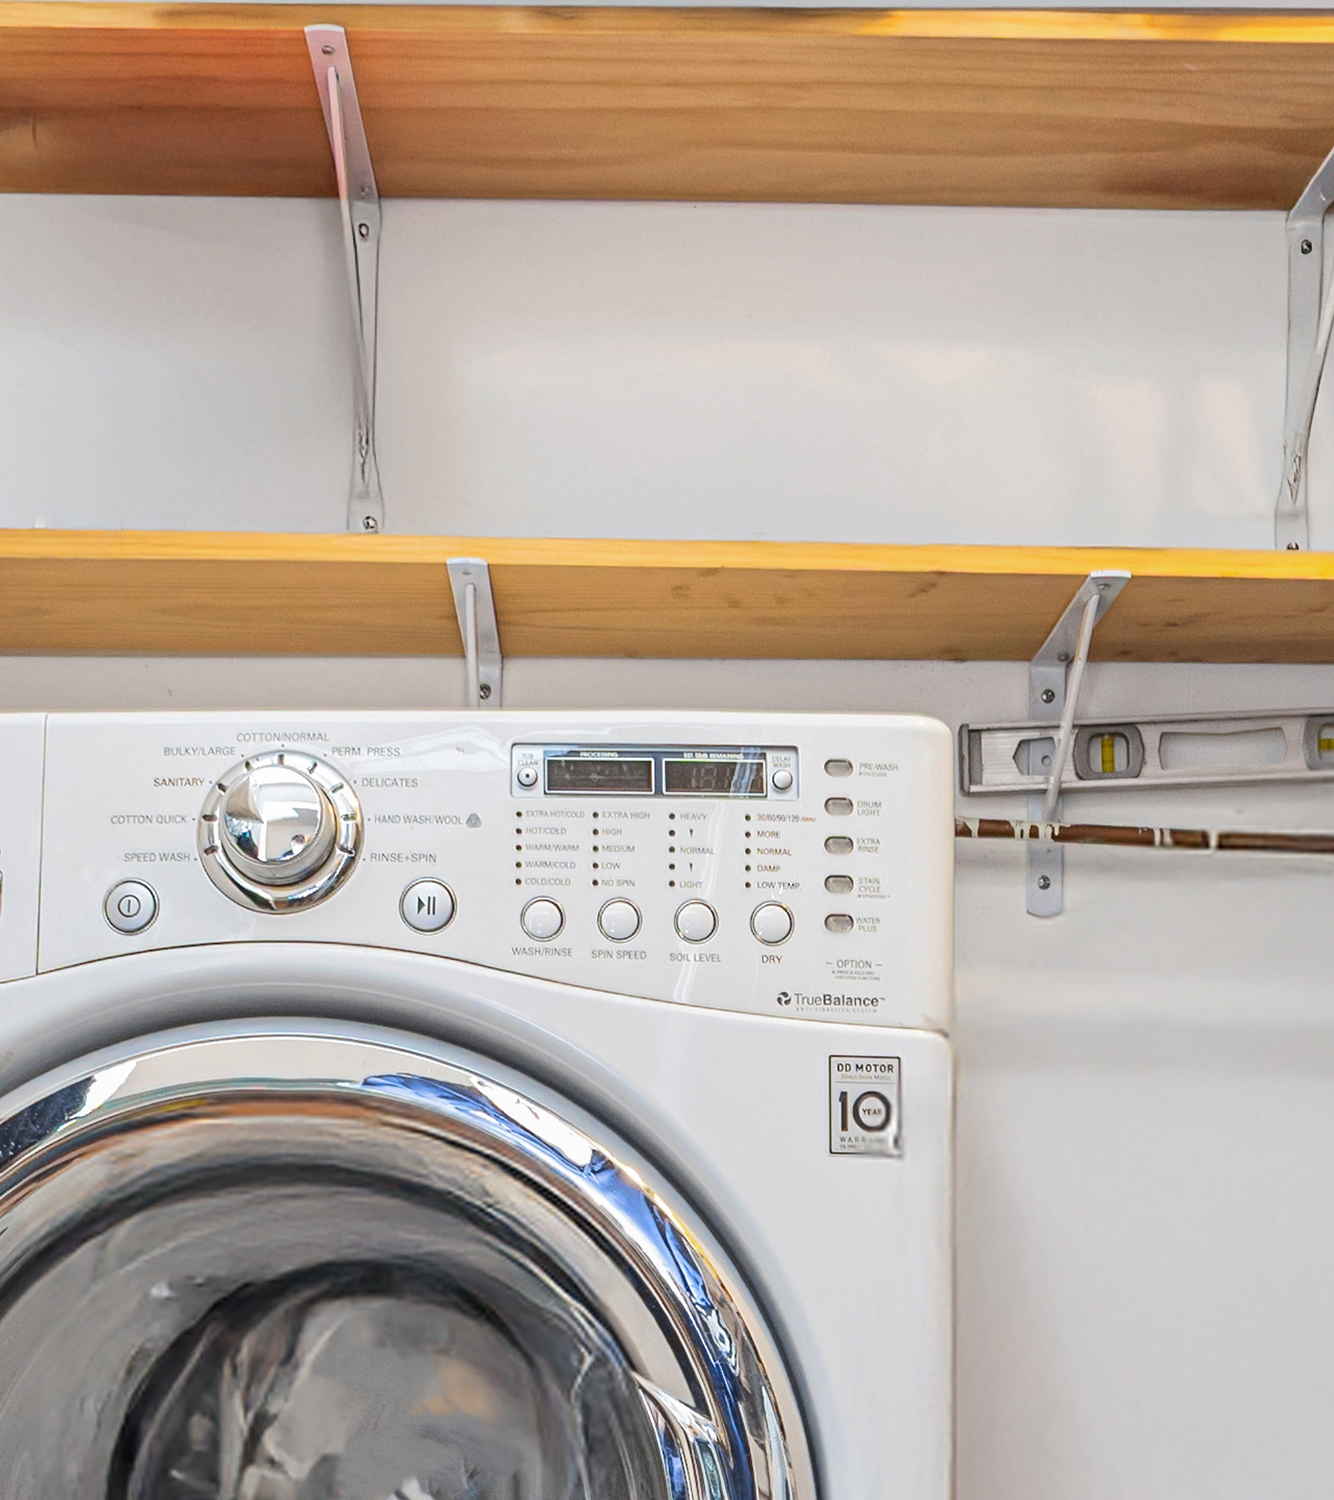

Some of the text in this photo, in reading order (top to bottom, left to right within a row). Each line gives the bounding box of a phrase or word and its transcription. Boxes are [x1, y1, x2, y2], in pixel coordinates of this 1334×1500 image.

[236, 732, 330, 743] COTTON/NORMAL
[163, 746, 237, 757] BULKY/LARGE
[331, 747, 401, 757] PERM. PRESS
[153, 778, 205, 788] SANITARY
[361, 778, 419, 788] DELICATES
[857, 801, 882, 809] DRUM
[525, 810, 549, 818] EXTRA
[601, 812, 651, 820] EXTRA HIGH
[679, 813, 708, 821] HEAVY
[857, 808, 881, 817] LIGHT
[110, 814, 188, 825] COTTON QUICK
[374, 815, 464, 825] HAND WASH/WOOL
[525, 827, 568, 836] HOT/COLD
[601, 828, 623, 836] HIGH
[756, 830, 781, 839] MORE
[856, 837, 881, 846] EXTRA
[524, 843, 580, 853] WARM/WARM
[601, 845, 636, 853] MEDIUM
[679, 847, 715, 856] NORMAL
[756, 848, 793, 857] NORMAL
[857, 846, 880, 854] RINSE
[123, 852, 191, 863] SPEED WASH
[370, 853, 437, 863] RINSE+SPIN
[524, 861, 577, 870] WARM/COLD
[601, 862, 622, 870] LOW
[756, 865, 782, 873] DAMP
[524, 877, 572, 886] COLD/COLD
[601, 879, 636, 887] NO SPIN
[679, 880, 703, 889] LIGHT
[756, 882, 776, 890] LOW
[858, 877, 881, 886] STAIN
[858, 885, 882, 894] CYCLE
[855, 917, 882, 925] WATER
[857, 925, 878, 933] PLUS
[511, 947, 574, 958] WASH/RINSE
[590, 949, 648, 960] SPIN SPEED
[669, 952, 723, 964] SOIL LEVEL
[761, 954, 783, 965] DRY
[836, 958, 873, 969] OPTION
[836, 1062, 895, 1074] DD MOTOR
[838, 1090, 892, 1133] 10
[861, 1108, 883, 1116] YEAR
